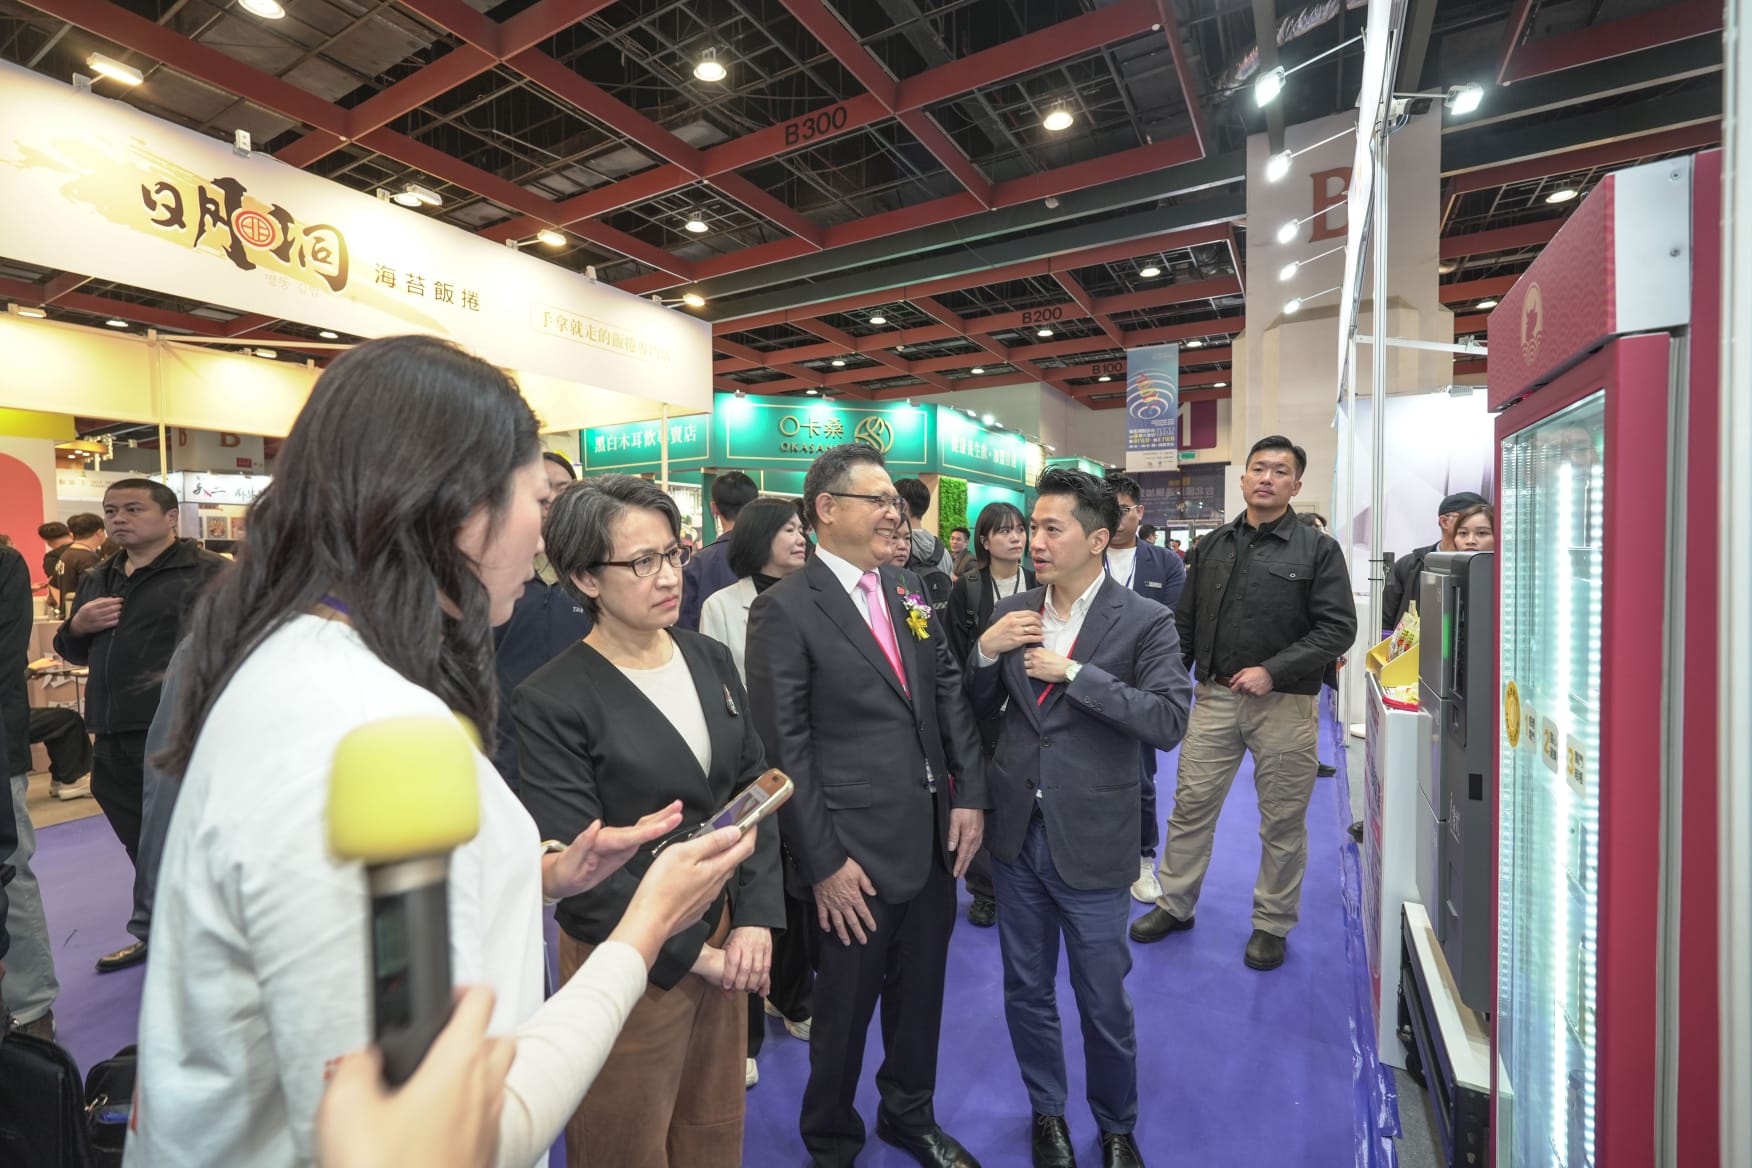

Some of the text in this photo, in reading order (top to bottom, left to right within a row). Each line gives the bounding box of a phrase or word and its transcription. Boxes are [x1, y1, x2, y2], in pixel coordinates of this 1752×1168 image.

[785, 106, 847, 144] B300
[374, 262, 481, 312] 海苔飯捲
[1022, 307, 1063, 325] B200
[1092, 362, 1123, 375] B100
